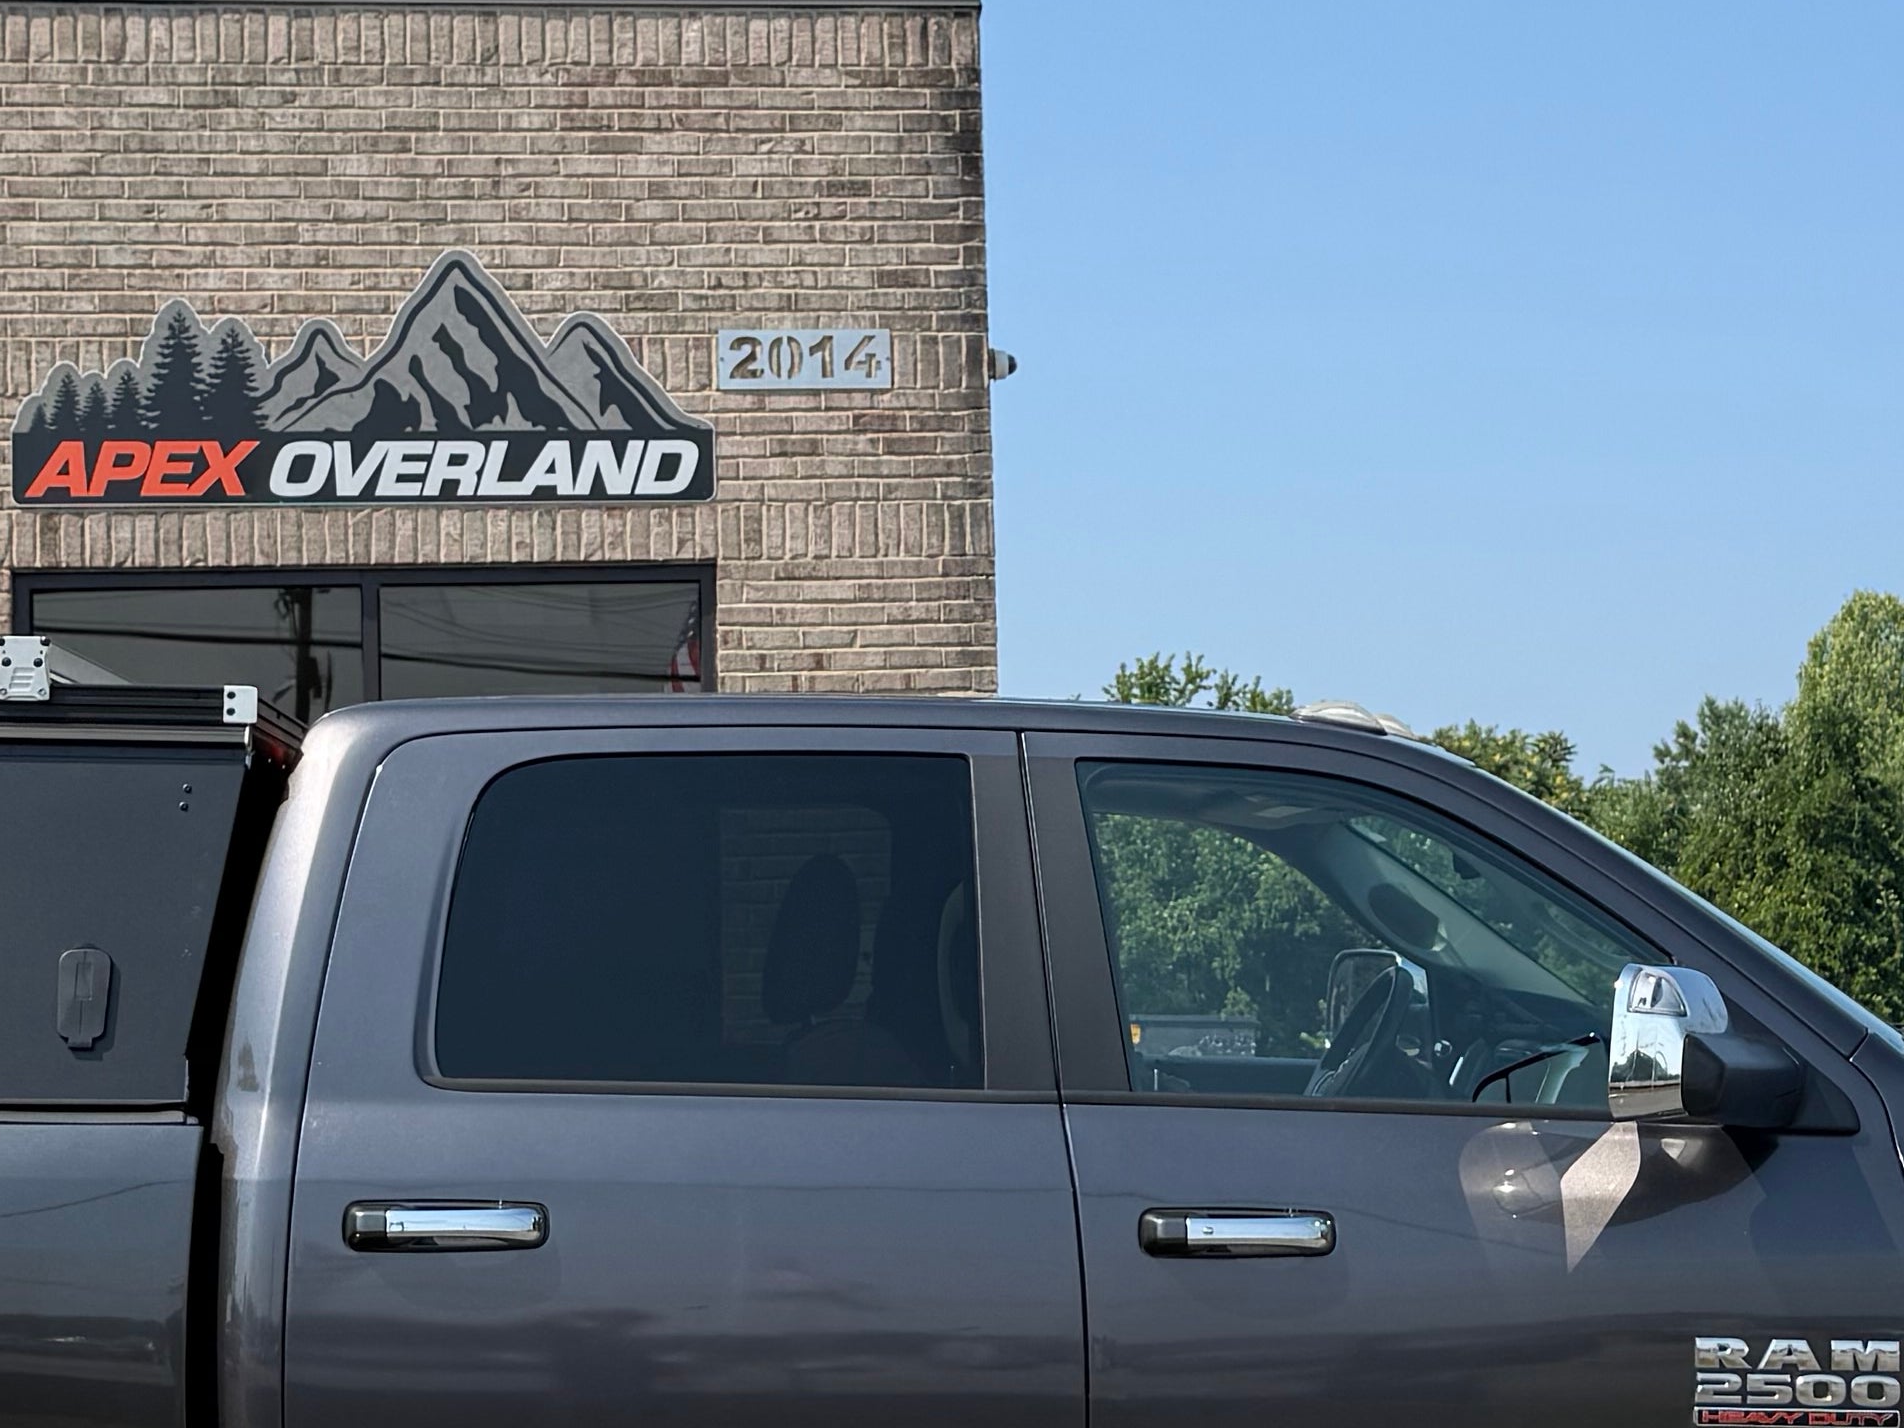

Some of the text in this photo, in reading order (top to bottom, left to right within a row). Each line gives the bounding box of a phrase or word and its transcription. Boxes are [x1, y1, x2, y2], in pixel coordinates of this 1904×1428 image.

[726, 336, 883, 380] 2014
[25, 439, 700, 498] APEX OVERLAND
[1695, 1337, 1900, 1372] RAM
[1695, 1372, 1900, 1408] 2500
[1702, 1410, 1894, 1426] HEAVY DUTY
